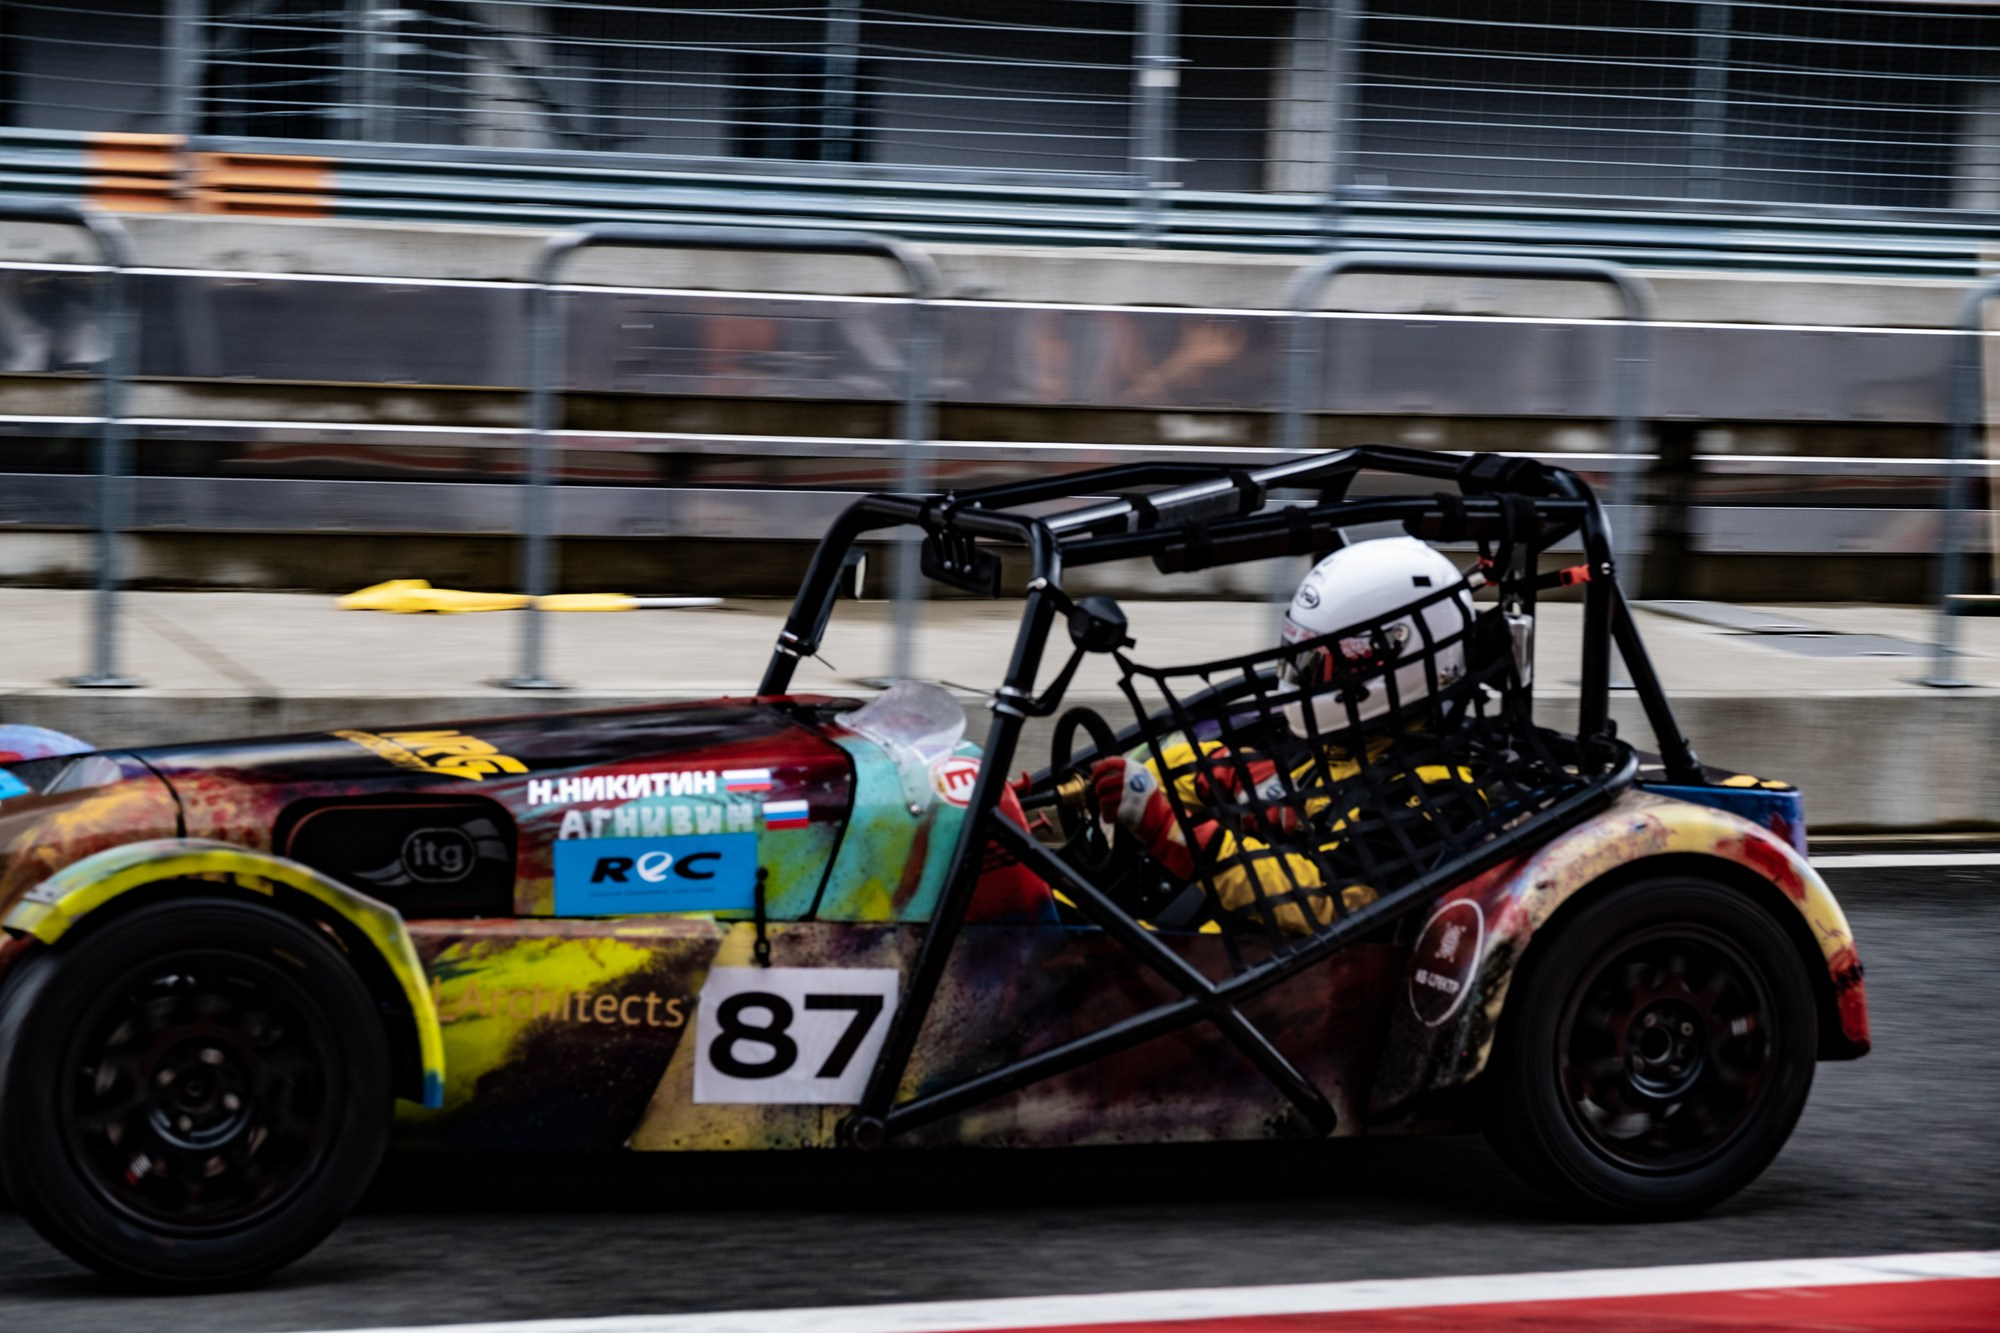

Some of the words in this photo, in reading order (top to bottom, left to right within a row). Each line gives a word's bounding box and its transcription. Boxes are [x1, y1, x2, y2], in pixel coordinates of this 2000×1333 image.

[527, 770, 716, 804] Н.НИКИТИН
[413, 838, 463, 872] itg
[709, 991, 885, 1079] 87
